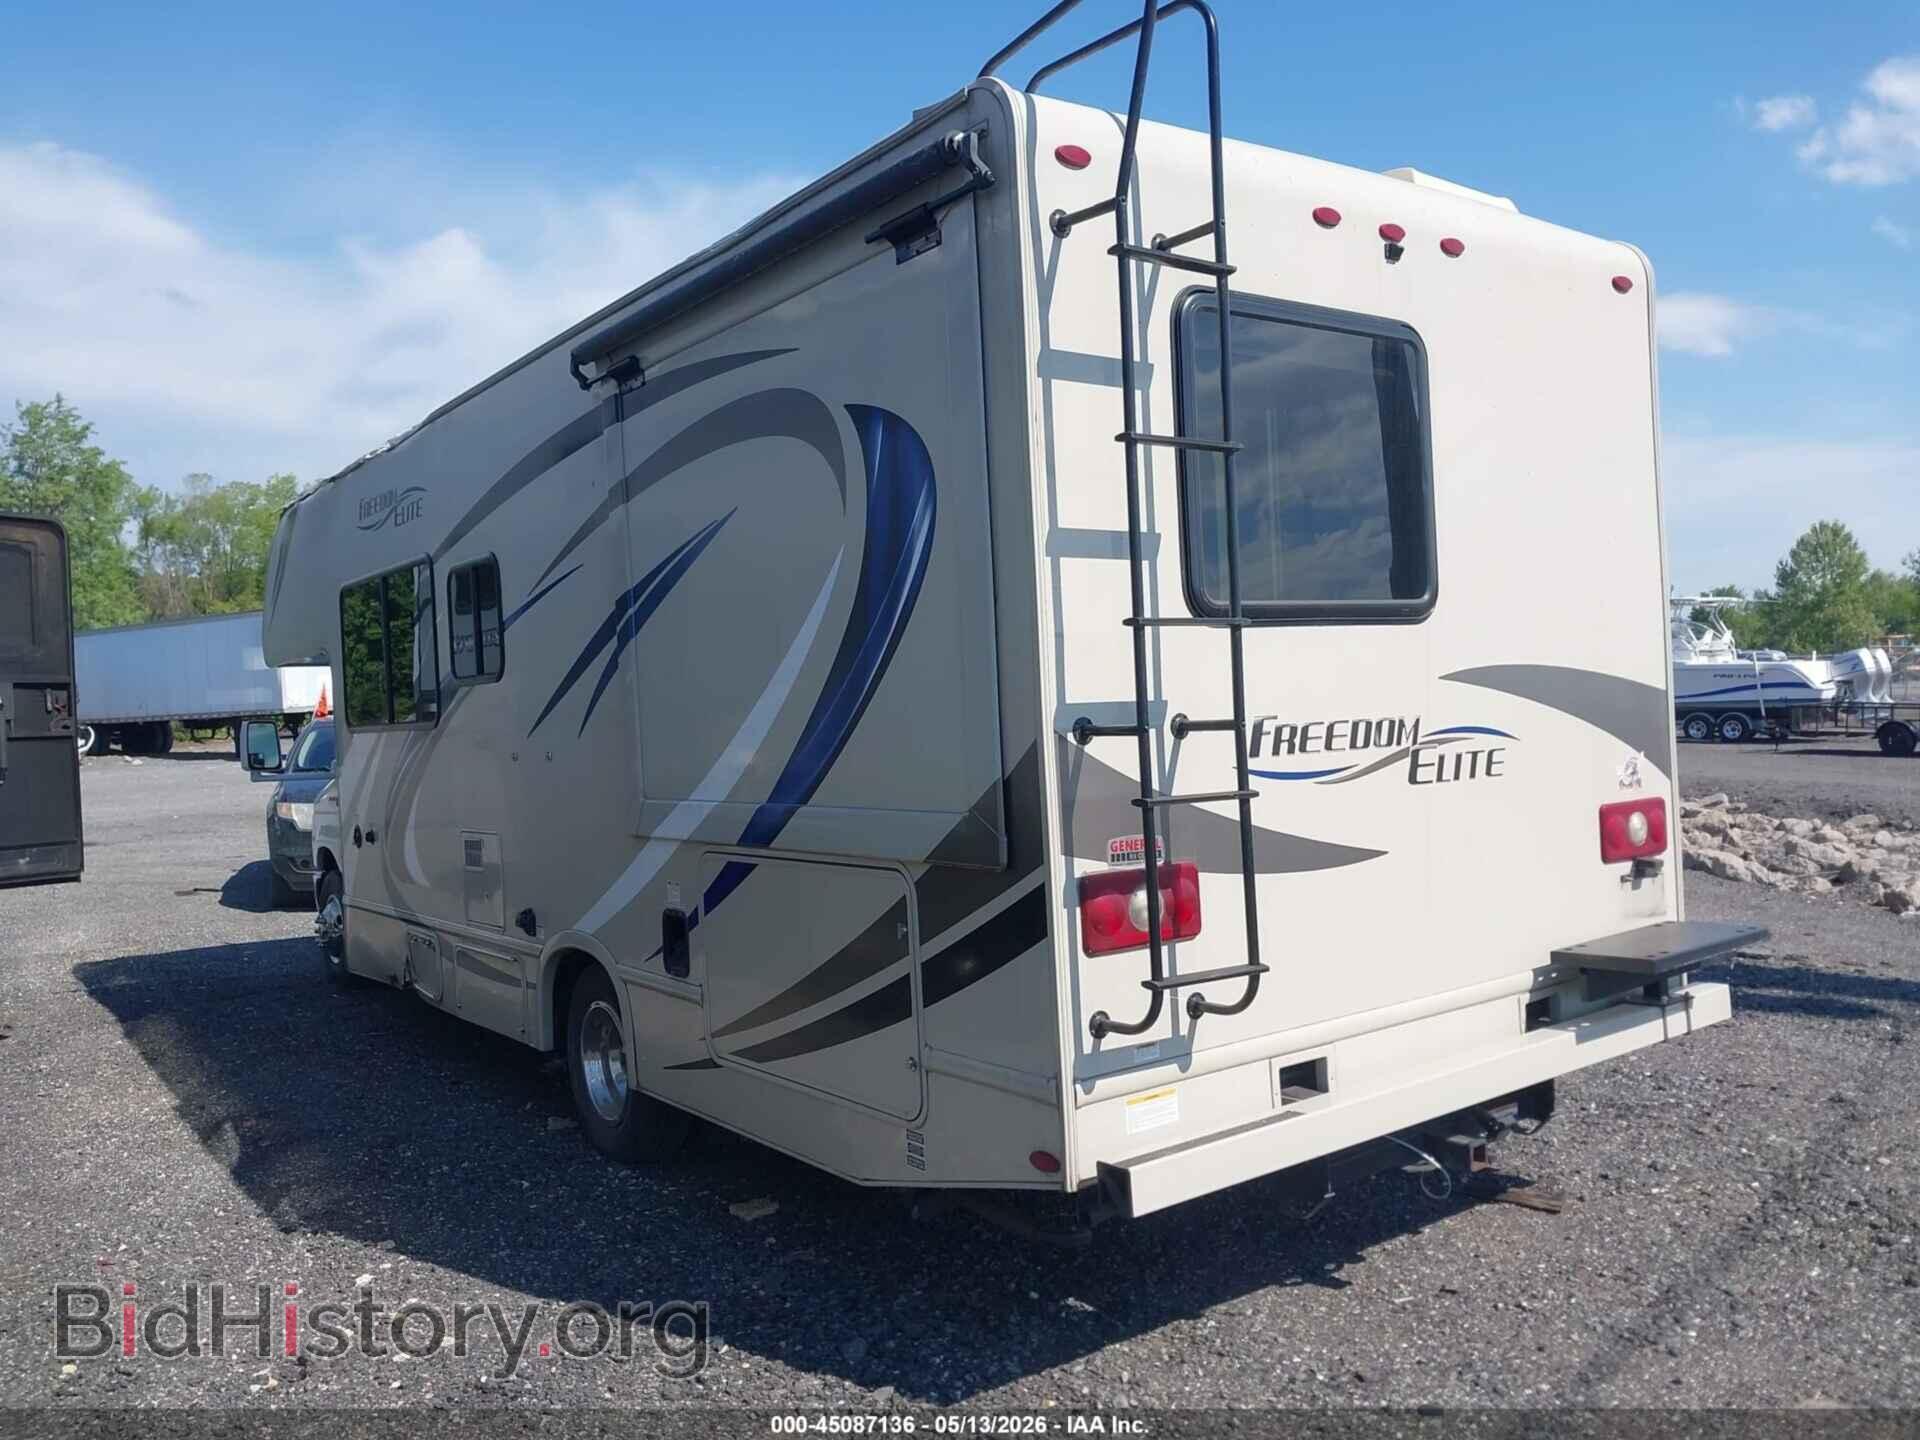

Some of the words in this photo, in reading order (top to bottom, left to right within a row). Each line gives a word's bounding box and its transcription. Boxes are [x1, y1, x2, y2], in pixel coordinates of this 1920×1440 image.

[394, 497, 424, 527] ELITE
[1249, 715, 1421, 759] FREEDOM
[1408, 745, 1506, 786] ELITE
